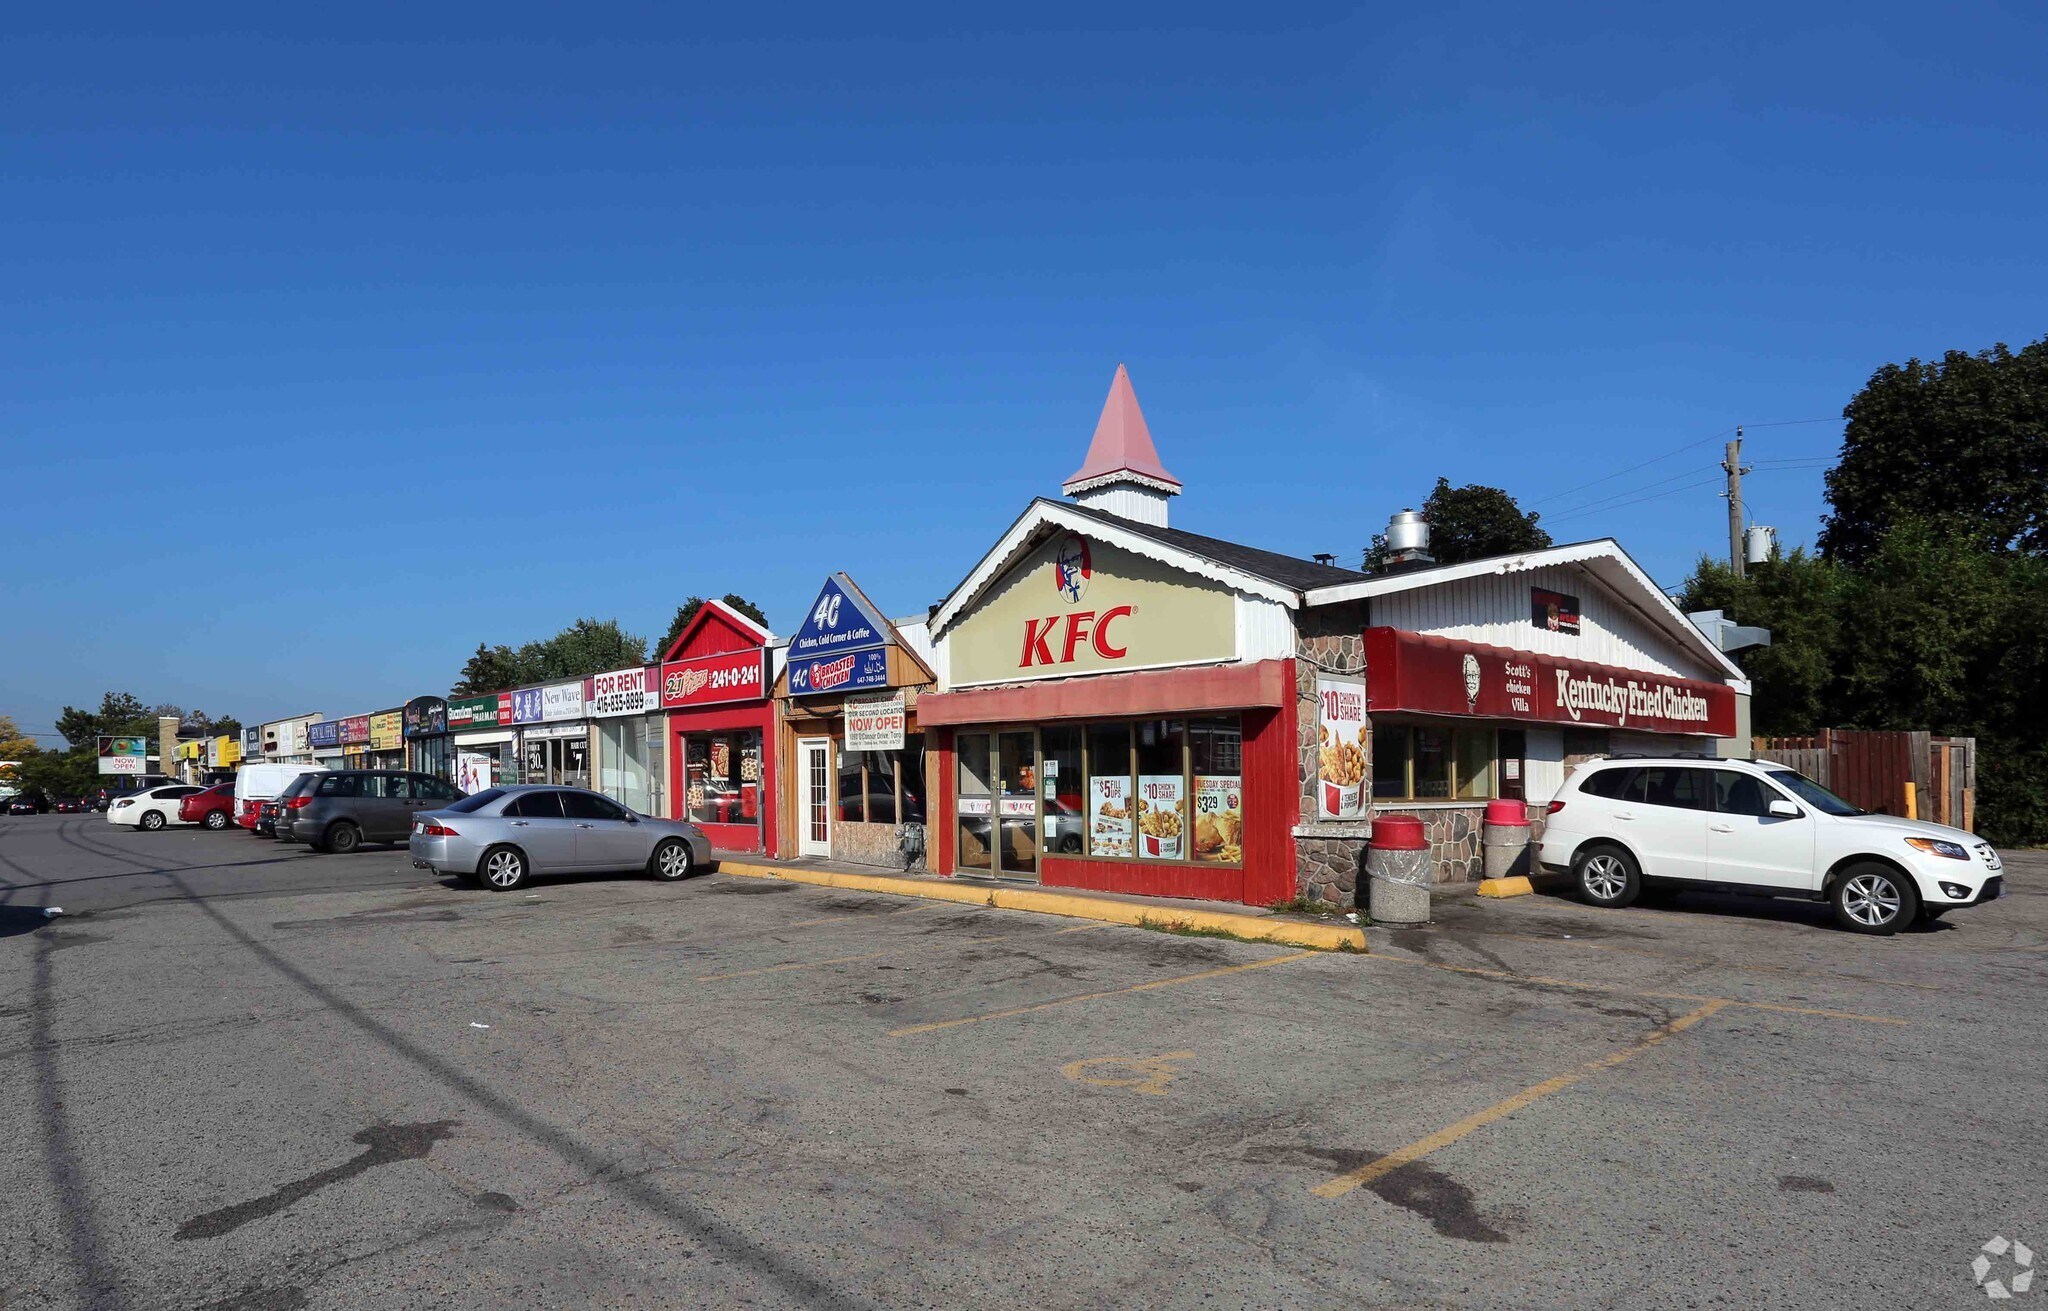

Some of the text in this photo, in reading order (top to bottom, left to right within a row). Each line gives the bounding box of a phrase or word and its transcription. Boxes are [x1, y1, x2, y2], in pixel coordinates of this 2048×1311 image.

[813, 593, 842, 630] 4C
[800, 637, 818, 648] Chicken,
[830, 631, 847, 643] Corner
[847, 630, 851, 640] &
[852, 628, 870, 639] Coffee
[1018, 605, 1132, 668] KFC
[821, 655, 855, 677] BROASTER
[1505, 661, 1531, 678] Scott's
[596, 672, 643, 695] FOR RENT
[792, 669, 807, 687] 4C
[822, 669, 850, 689] CHICKEN
[1506, 679, 1531, 695] chicken
[544, 688, 580, 705] New Wave
[1511, 697, 1529, 712] Villa
[1556, 669, 1708, 726] Kentucky Fried Chicken
[1320, 690, 1339, 721] $10
[1340, 705, 1361, 722] SHARE
[849, 718, 872, 731] NOW
[1099, 780, 1121, 798] $5 FILL
[1144, 783, 1157, 799] $10
[1220, 780, 1241, 789] SPECIAL
[1110, 789, 1121, 798] UPS
[1158, 791, 1175, 799] SHARE
[1019, 802, 1034, 811] KFC
